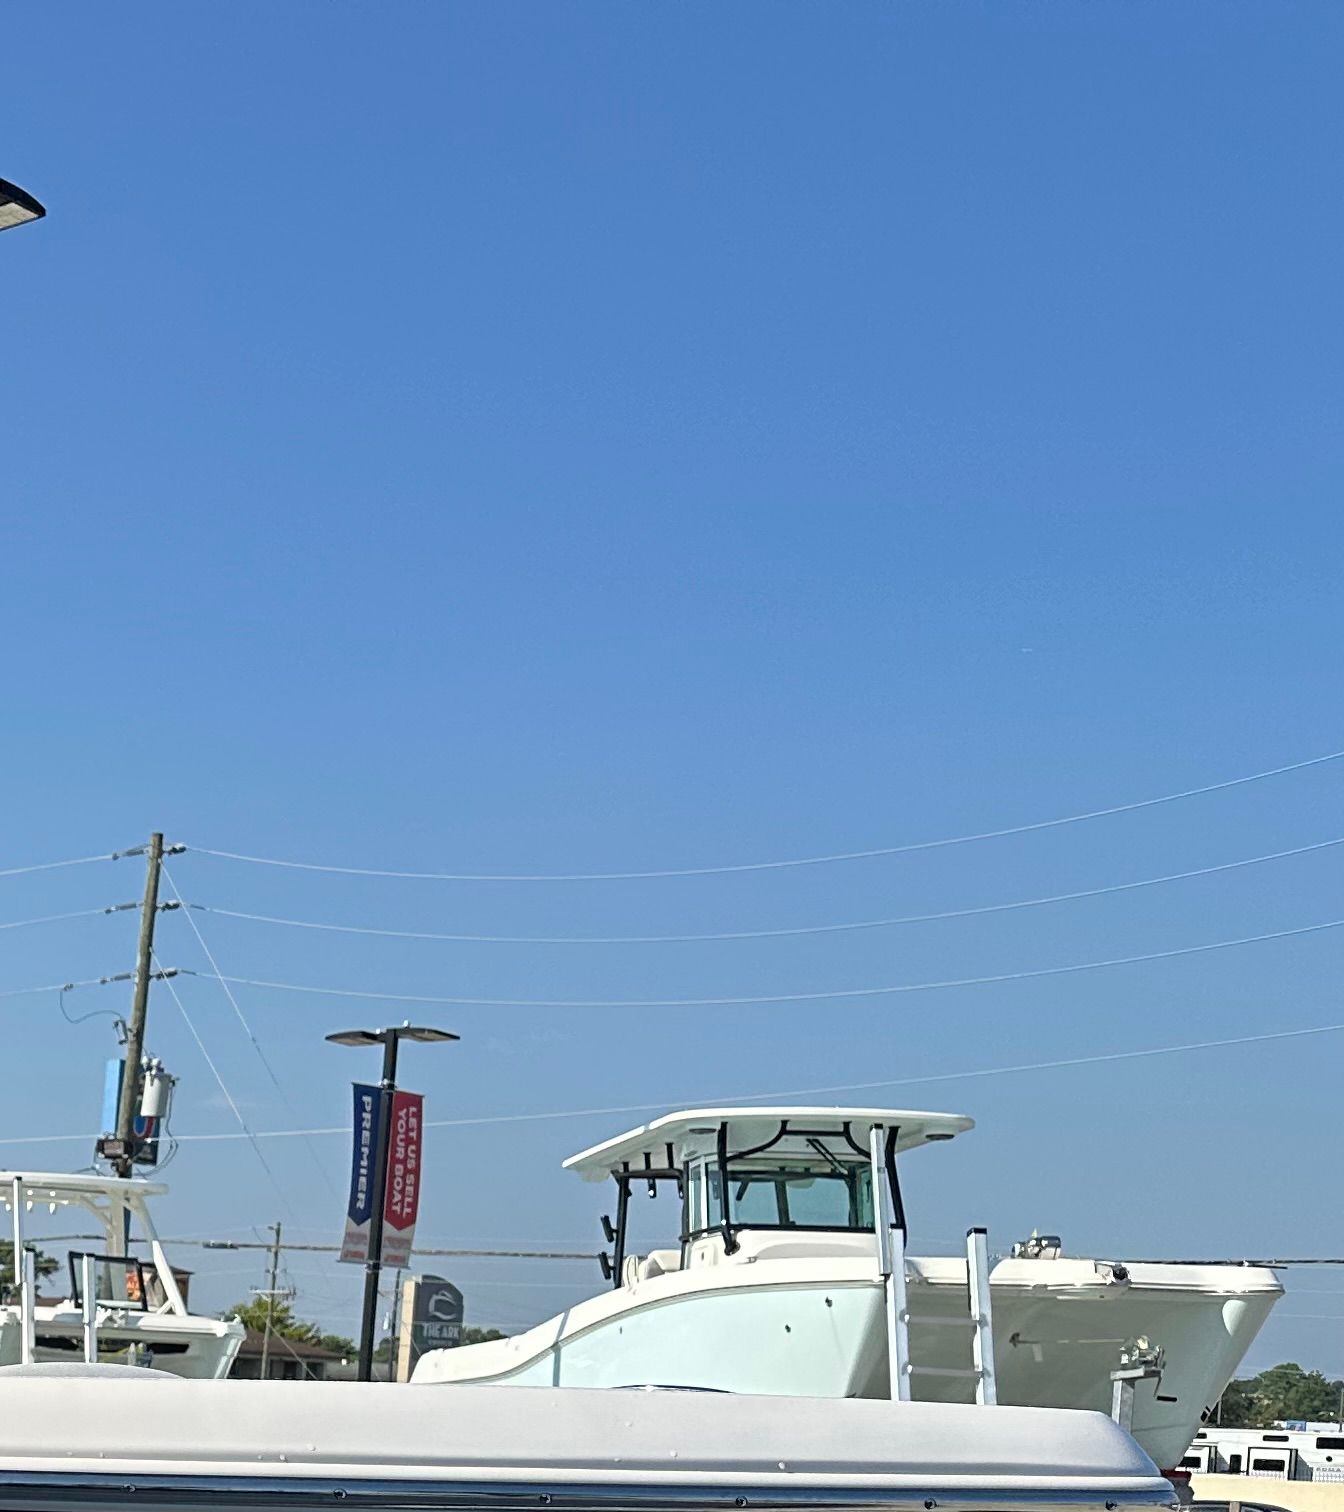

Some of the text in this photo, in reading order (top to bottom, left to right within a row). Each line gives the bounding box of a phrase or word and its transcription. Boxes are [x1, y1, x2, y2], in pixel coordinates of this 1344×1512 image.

[356, 1095, 373, 1210] PREMIER
[392, 1108, 407, 1215] YOUR BOAT
[403, 1107, 418, 1219] LET US SELL
[422, 1323, 459, 1339] THE ARK
